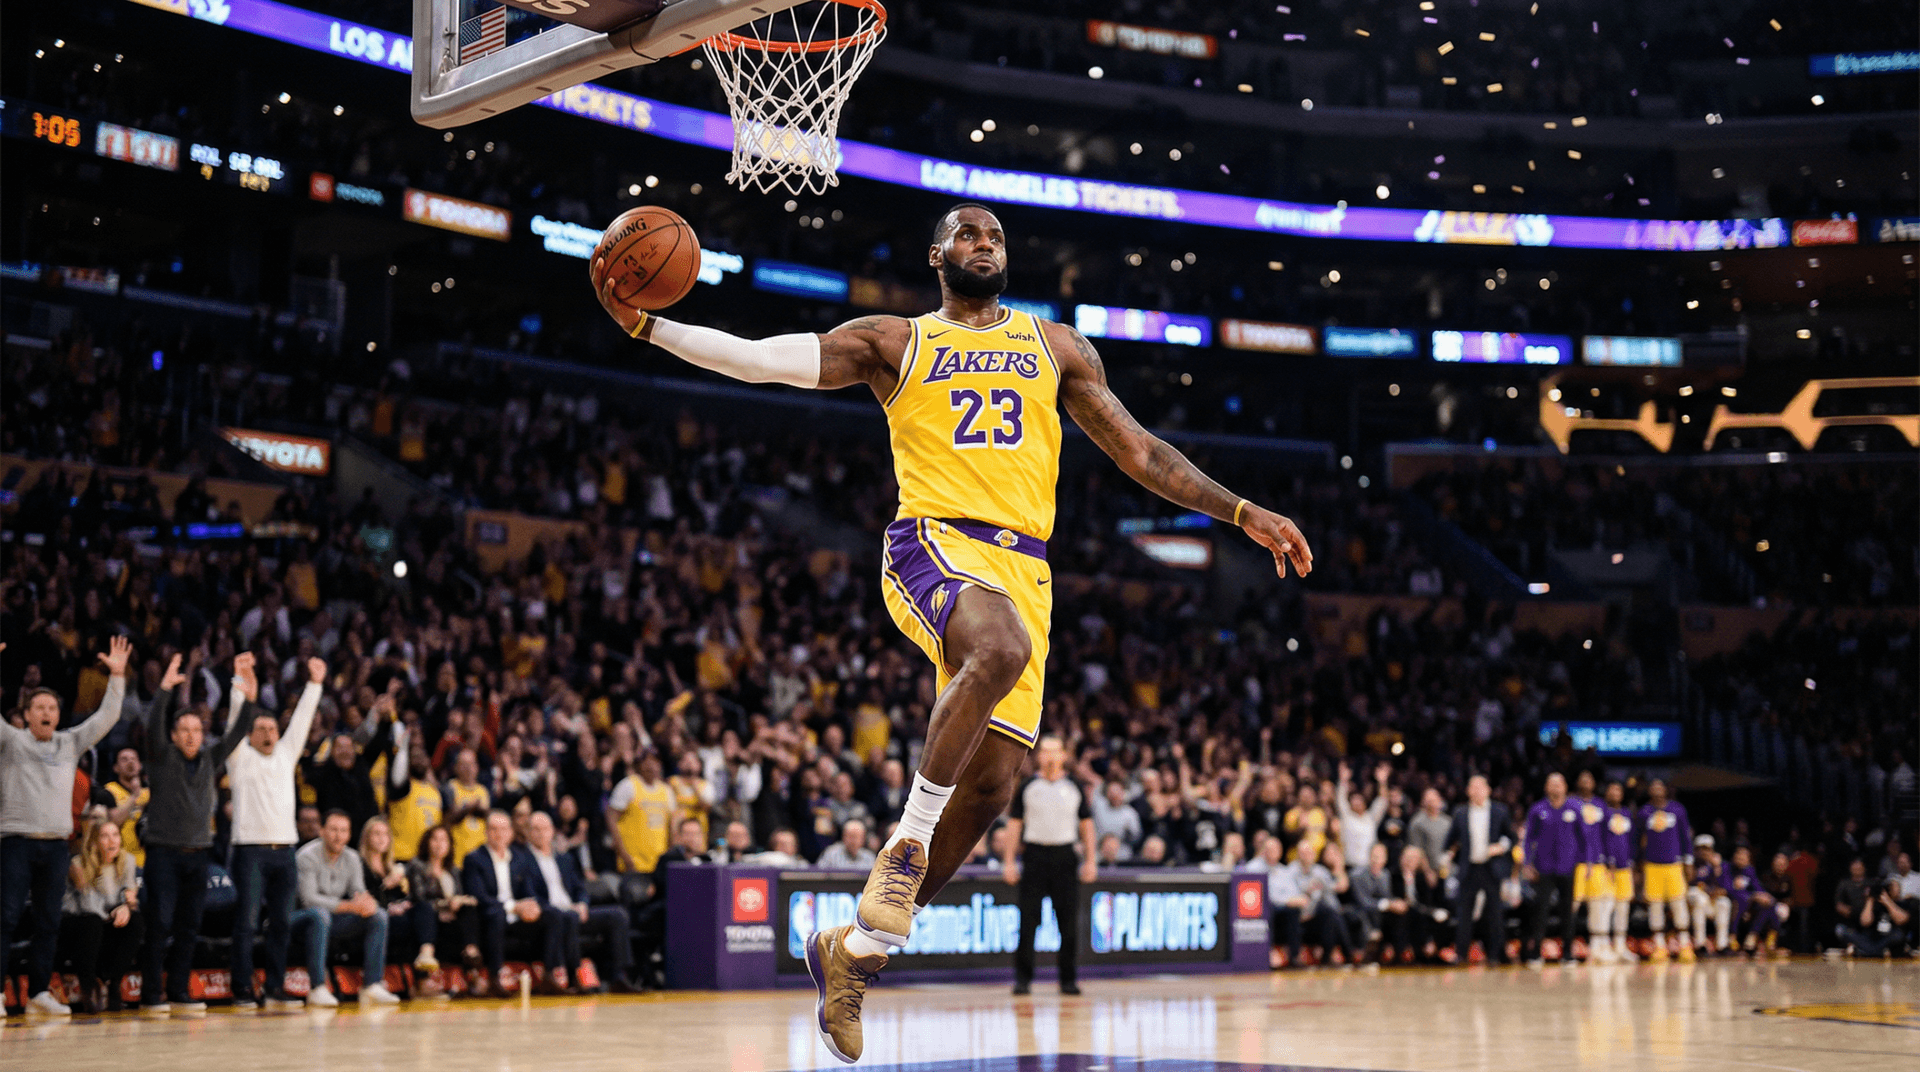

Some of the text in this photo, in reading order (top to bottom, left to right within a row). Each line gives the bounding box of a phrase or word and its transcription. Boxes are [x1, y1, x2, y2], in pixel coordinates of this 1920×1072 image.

[330, 21, 385, 62] LOS
[921, 159, 966, 193] LOS
[966, 169, 1079, 207] ANGELES
[922, 346, 1040, 385] LAKERS
[950, 388, 1023, 450] 23
[1113, 892, 1218, 951] PLAYOFFS
